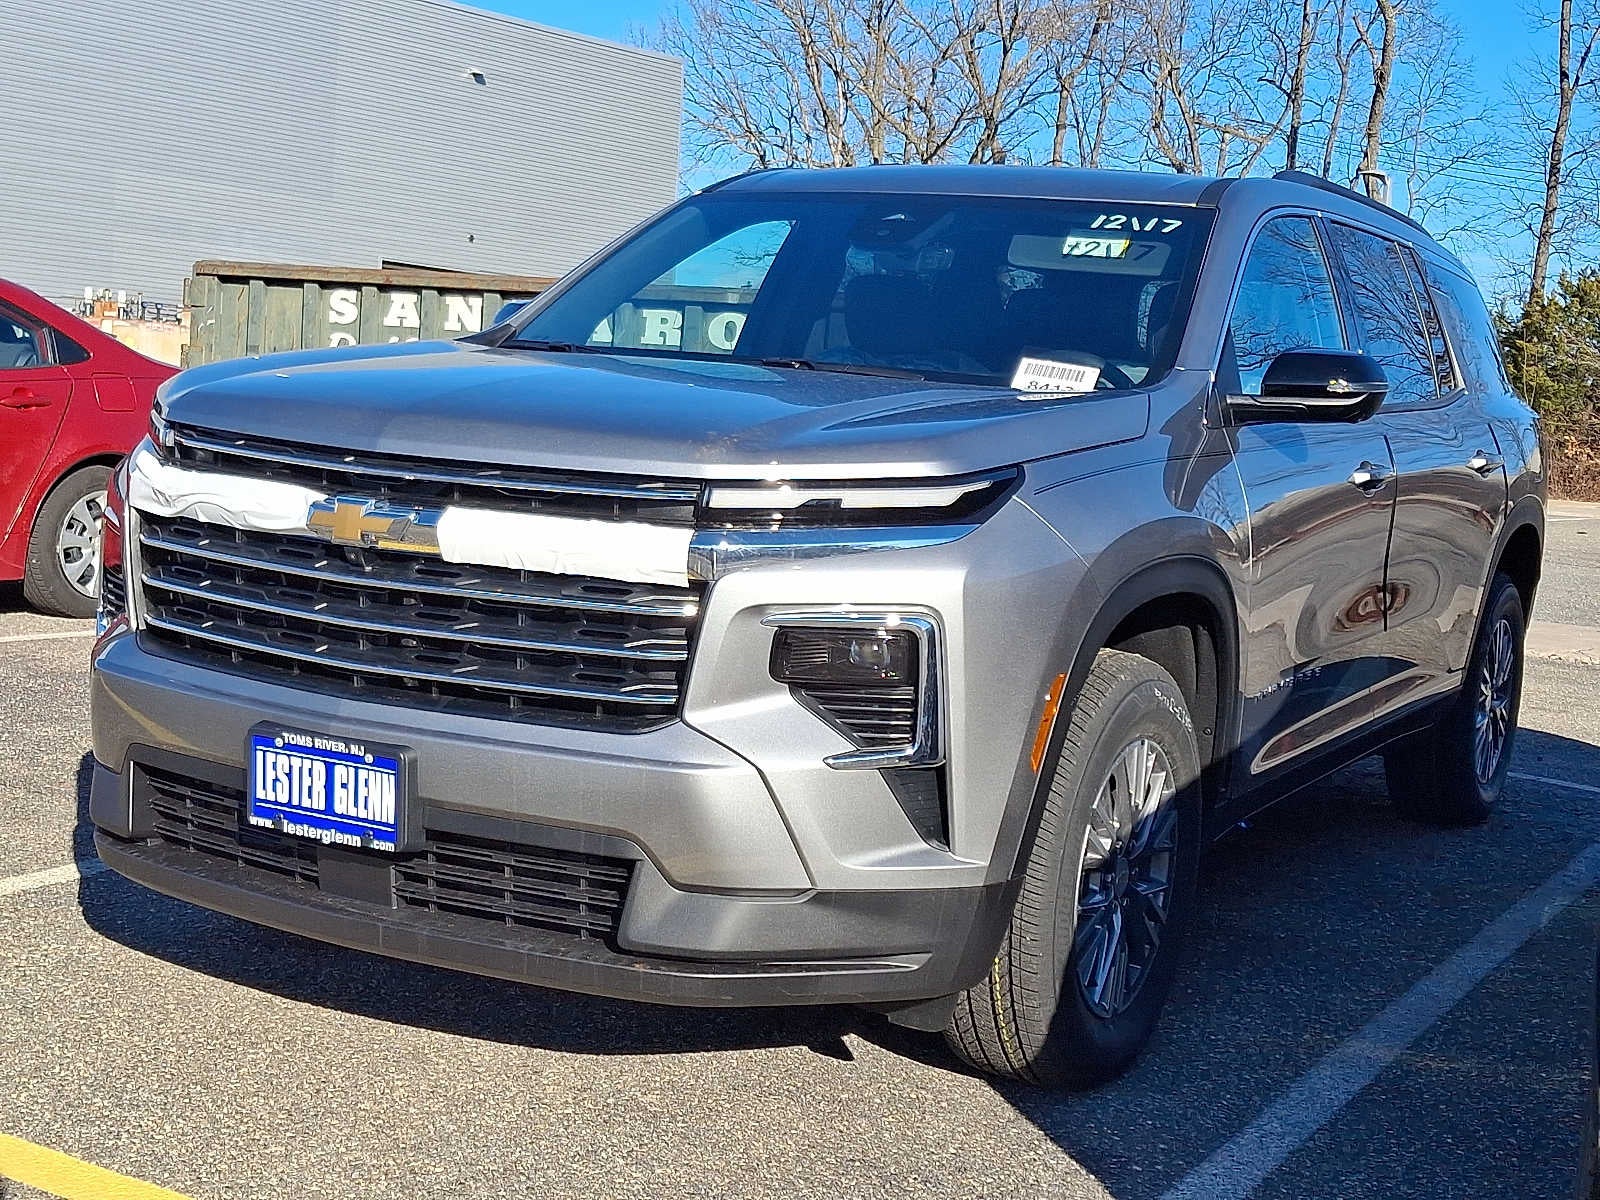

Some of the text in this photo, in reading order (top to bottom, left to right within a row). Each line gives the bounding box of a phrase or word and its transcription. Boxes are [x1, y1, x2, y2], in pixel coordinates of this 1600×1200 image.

[282, 732, 365, 756] TOMS RIVER, NJ
[255, 749, 396, 825] LESTER GLENN
